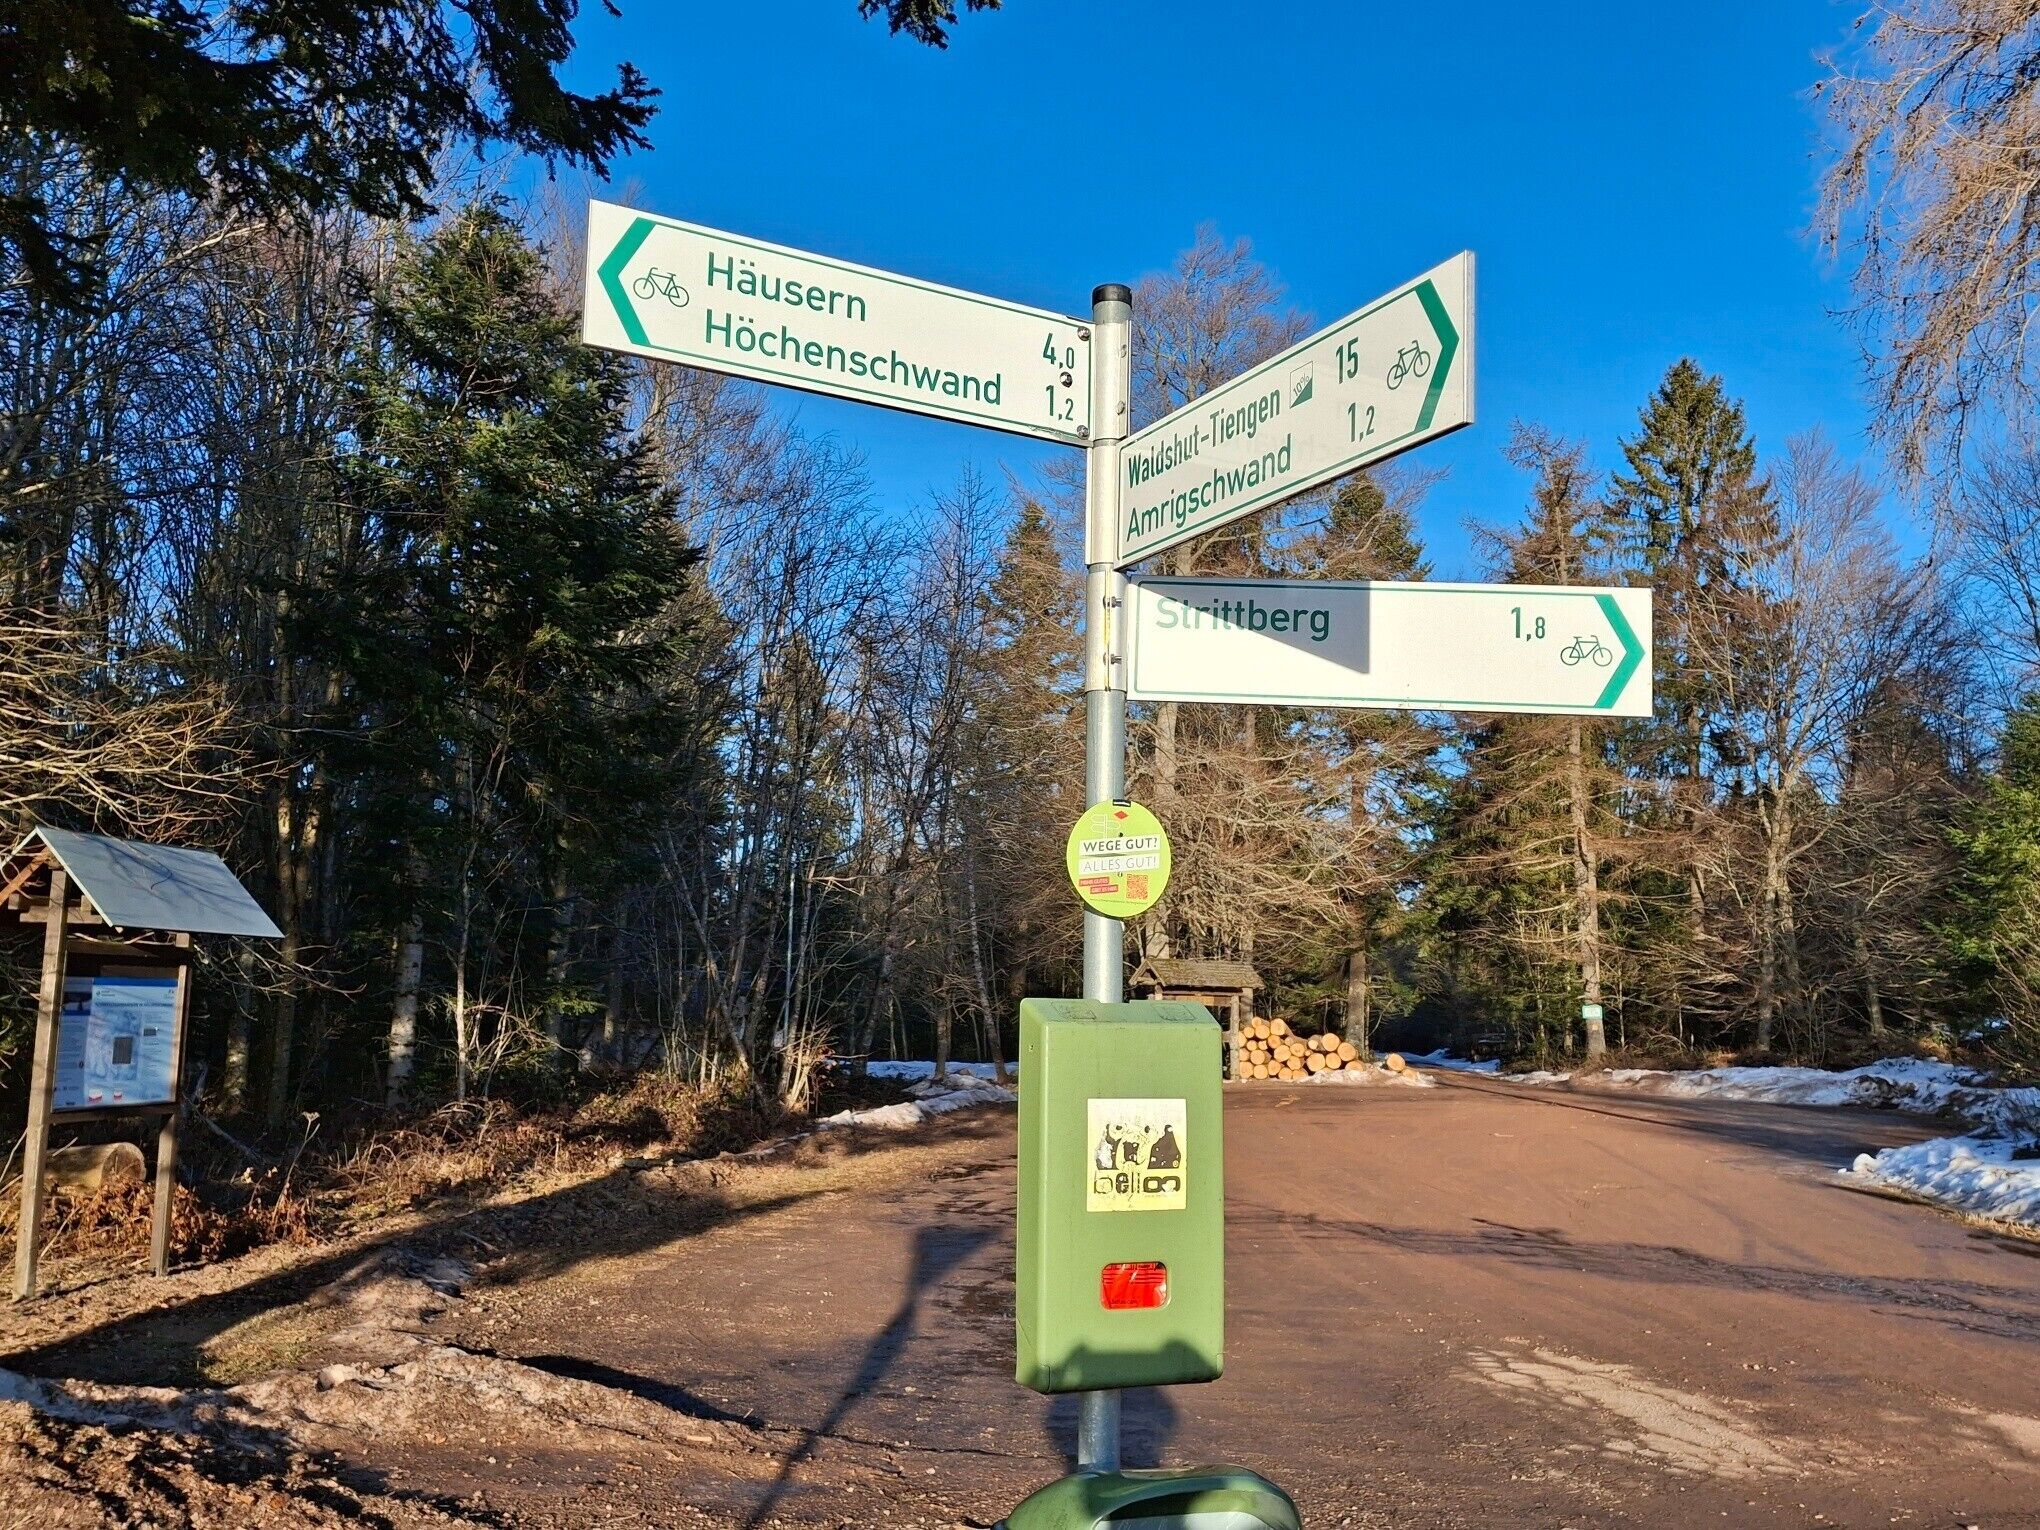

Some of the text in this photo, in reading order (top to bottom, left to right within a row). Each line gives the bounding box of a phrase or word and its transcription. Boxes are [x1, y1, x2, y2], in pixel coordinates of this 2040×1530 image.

[707, 251, 866, 322] Häusern
[705, 309, 1001, 406] Höchenschwand
[1042, 333, 1075, 370] 4,0
[1335, 336, 1359, 385] 15
[1045, 385, 1075, 422] 1,2
[1347, 402, 1375, 443] 1,2
[1127, 388, 1281, 488] Waldshut-Tiengen
[1126, 433, 1292, 542] Amrigschwand
[1155, 597, 1331, 642] Strittberg
[1510, 606, 1546, 642] 1,8
[1083, 837, 1158, 853] WEGE GUT?
[1083, 856, 1157, 872] ALLES GUT!
